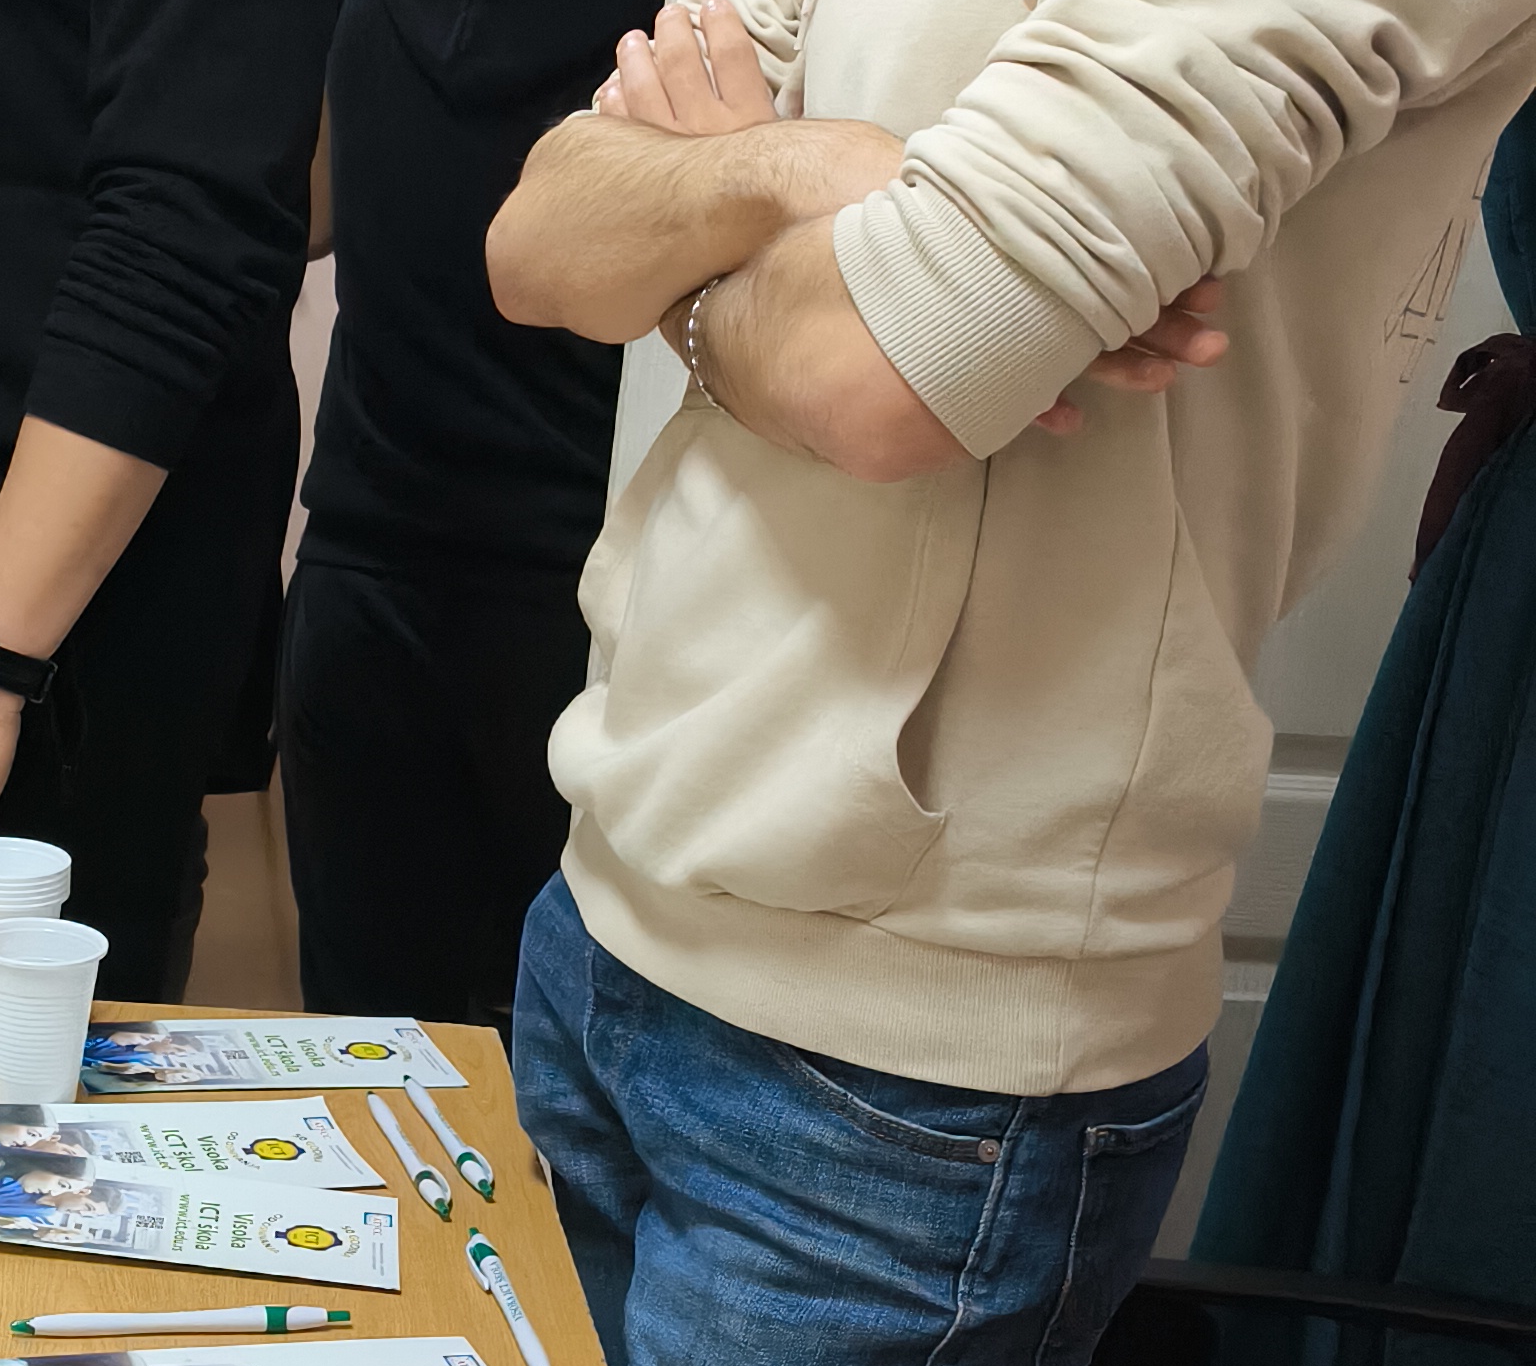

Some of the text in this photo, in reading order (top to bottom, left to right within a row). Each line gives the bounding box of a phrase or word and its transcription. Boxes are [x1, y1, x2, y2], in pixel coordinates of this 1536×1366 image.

[264, 1035, 289, 1049] ICT
[297, 1038, 326, 1067] Visoka
[162, 1130, 188, 1148] ICT
[197, 1136, 229, 1171] Visoka
[266, 1143, 287, 1155] ICT
[171, 1194, 190, 1252] www.ict.edu.rs
[195, 1201, 221, 1251] ICT škola
[230, 1213, 254, 1249] Visoka
[304, 1230, 320, 1245] ICT
